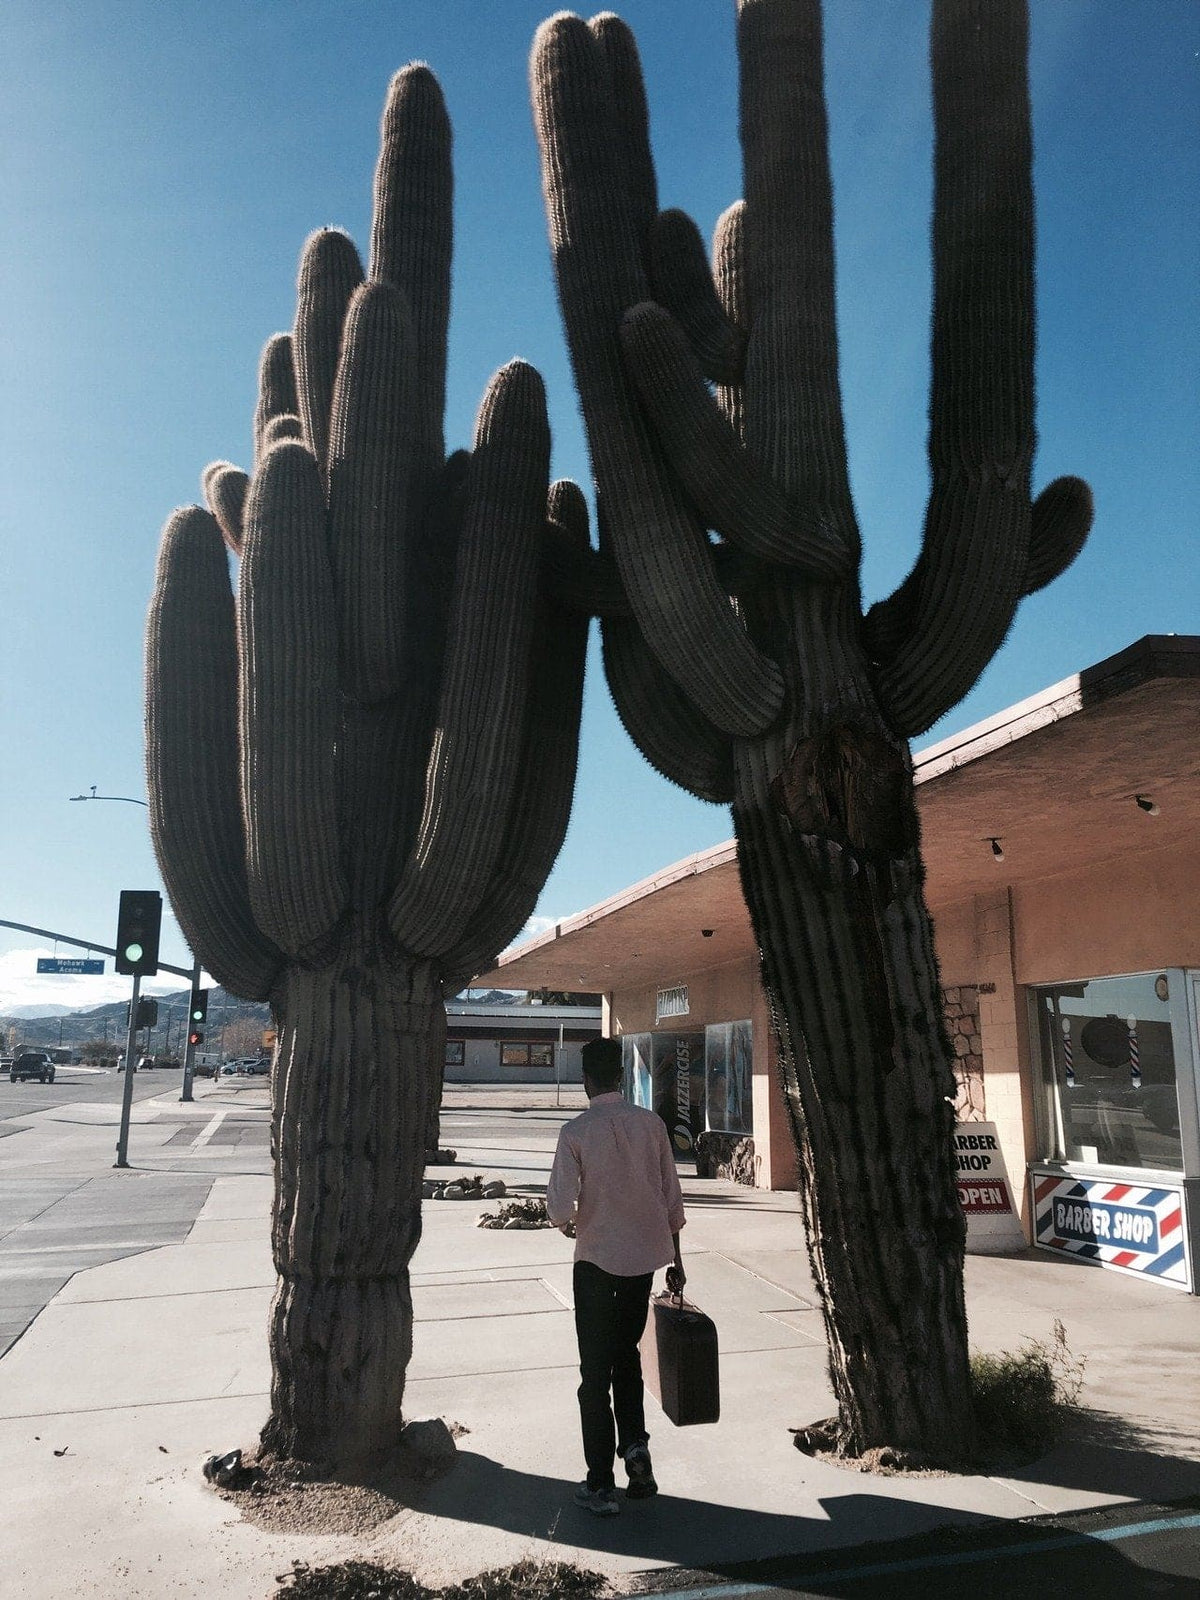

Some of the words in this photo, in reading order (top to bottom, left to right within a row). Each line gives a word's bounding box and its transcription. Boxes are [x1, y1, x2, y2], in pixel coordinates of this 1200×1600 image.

[677, 1040, 691, 1124] JAZZERCISE
[957, 1187, 1003, 1205] OPEN
[1057, 1203, 1111, 1240] BARBER
[1113, 1211, 1154, 1245] SHOP
